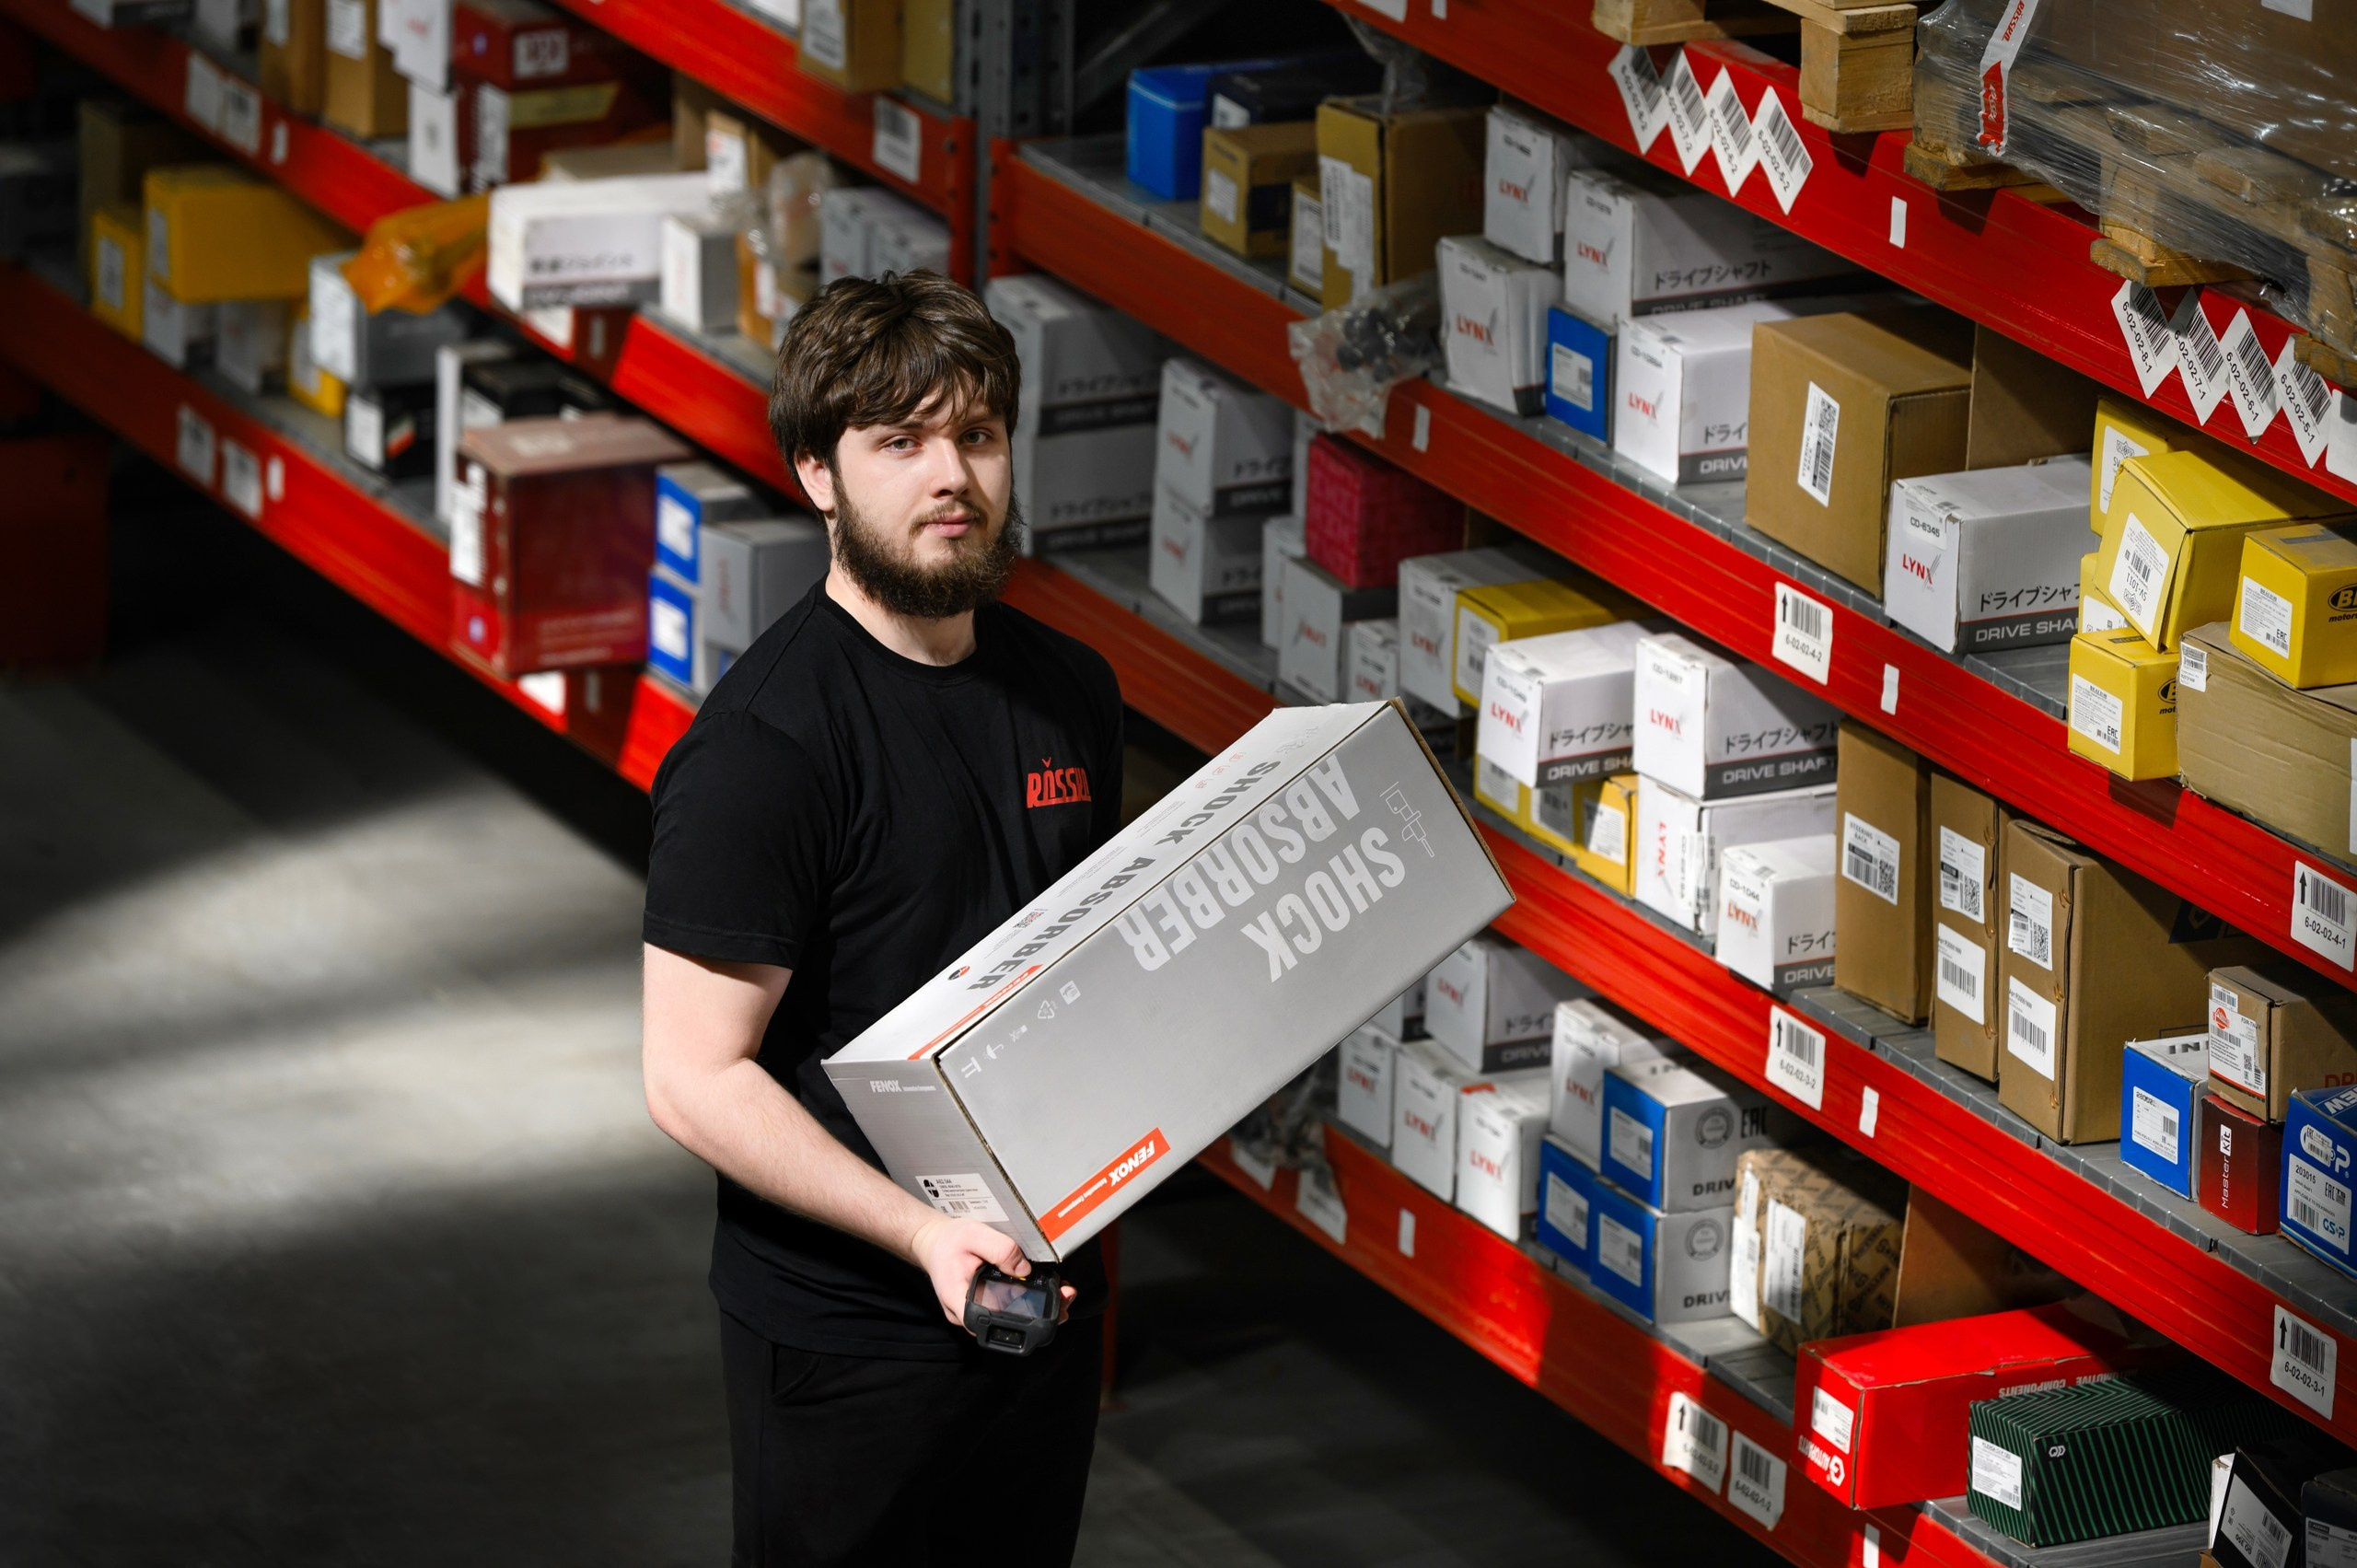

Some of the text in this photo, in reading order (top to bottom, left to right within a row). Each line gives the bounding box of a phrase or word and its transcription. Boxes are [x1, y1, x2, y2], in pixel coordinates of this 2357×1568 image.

[1758, 129, 1791, 192] 6-02-02-5-2
[1498, 175, 1532, 207] LYNX
[1577, 239, 1610, 267] LYNX
[1654, 260, 1772, 290] ドライブシャフト
[1456, 314, 1496, 347] LYNX
[2122, 301, 2153, 374] 6-02-02-8-1
[2174, 329, 2206, 401] 6-02-02-7-1
[2226, 351, 2259, 422] 6-02-02-6-1
[1628, 390, 1661, 421] LYNX
[2280, 373, 2316, 444] 6-02-02-5-1
[1699, 456, 1747, 474] DRIV
[1910, 516, 1941, 539] CD-6345
[1901, 552, 1938, 587] LYNX
[2126, 572, 2149, 602] SV-1011
[1975, 616, 2078, 644] DRIVE SHA
[2276, 628, 2288, 643] EAC
[1785, 633, 1823, 663] 6-02-02-4-2
[1490, 702, 1525, 734] LYNX
[1650, 707, 1683, 737] LYNX
[2107, 725, 2119, 740] EAC
[1724, 721, 1839, 755] ドライブシャフト
[1547, 759, 1600, 781] DRIVE
[1722, 766, 1775, 785] DRIVE
[1155, 759, 1281, 847] SHOCK
[1120, 754, 1361, 972] ABSORBER
[1241, 826, 1406, 983] SHOCK
[1727, 900, 1760, 931] LYNX
[967, 856, 1156, 991] ABSORBER
[2305, 915, 2346, 949] 6-02-02-4-1
[1783, 965, 1835, 984] DRIVE
[2169, 1040, 2209, 1055] IN
[869, 1079, 902, 1093] FENOX
[1779, 1059, 1817, 1090] 6-02-02-3-2
[2324, 1086, 2357, 1115] EW
[1108, 1139, 1156, 1188] FENOX
[2221, 1130, 2232, 1209] Master kit
[2295, 1164, 2316, 1185] 203015
[2324, 1181, 2335, 1202] EAC
[1683, 1290, 1730, 1308] DRIV
[1998, 1377, 2066, 1399] COMPONENTS
[2284, 1361, 2326, 1398] 6-02-02-3-1
[1797, 1434, 1831, 1472] AUTOPARTS
